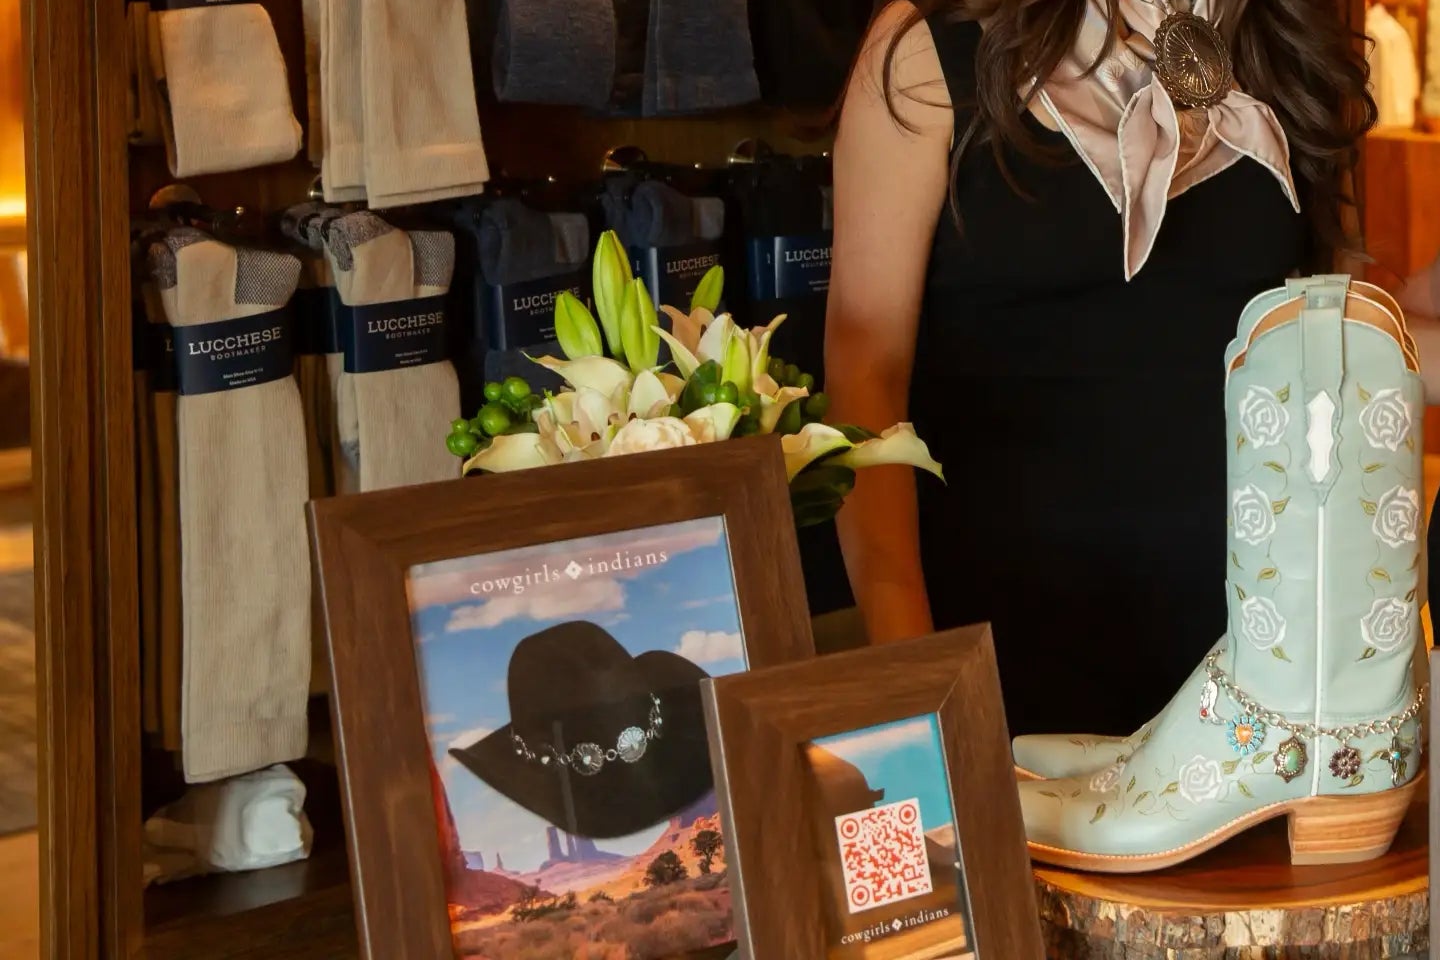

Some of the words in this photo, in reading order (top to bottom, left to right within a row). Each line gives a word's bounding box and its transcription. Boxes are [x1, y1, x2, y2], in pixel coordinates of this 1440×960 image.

[368, 312, 444, 333] LUCCHESE
[188, 327, 282, 355] LUCCHESE
[210, 345, 266, 361] BOOTMAKER
[470, 564, 559, 595] cowgirls
[587, 550, 669, 575] indians
[841, 921, 890, 945] cowgirls
[904, 908, 949, 928] indians
